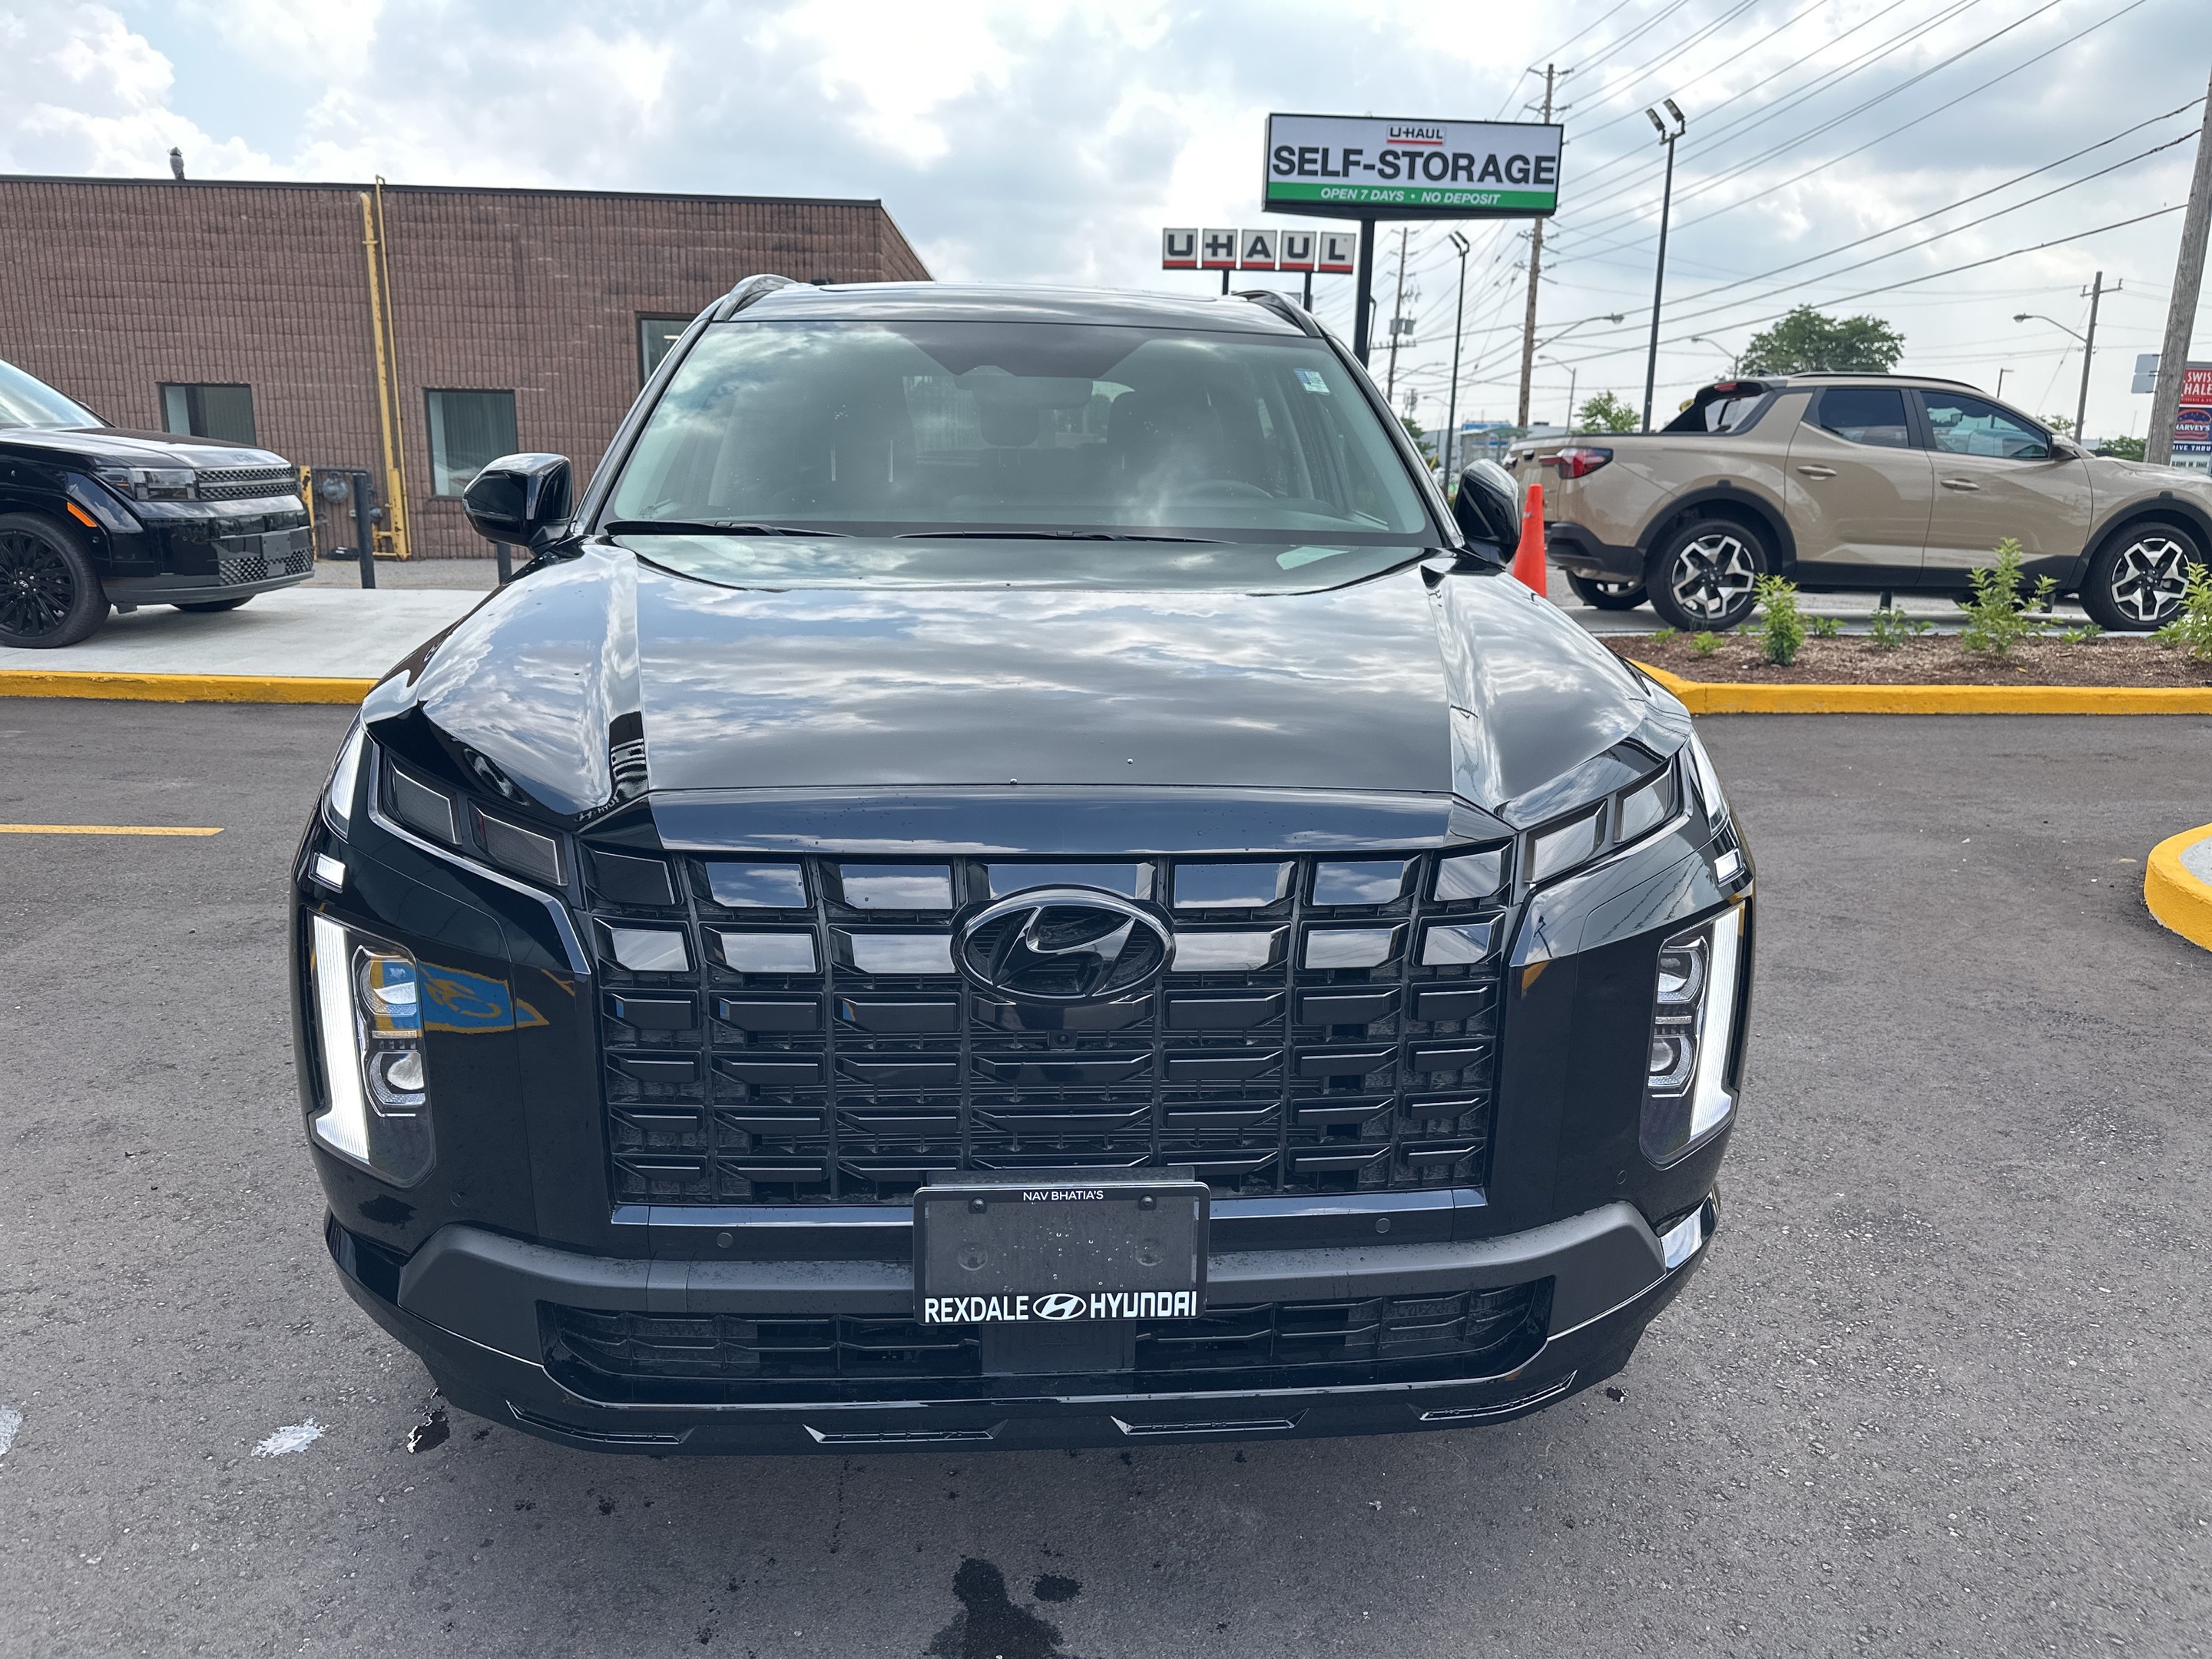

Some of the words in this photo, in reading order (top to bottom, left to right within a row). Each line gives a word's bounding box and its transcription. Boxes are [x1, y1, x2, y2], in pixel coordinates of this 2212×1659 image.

[1272, 144, 1556, 186] SELF-STORAGE
[1320, 187, 1357, 200] OPEN
[1360, 189, 1369, 200] 7
[1370, 190, 1405, 202] DAYS
[1421, 192, 1442, 204] NO
[1443, 193, 1501, 204] DEPOSIT
[2187, 372, 2212, 382] SWIS
[2182, 382, 2212, 396] HALE
[1023, 1190, 1049, 1201] NAV
[1051, 1190, 1104, 1200] BHATIA'S
[925, 1295, 1029, 1323] REXDALE
[1090, 1290, 1197, 1319] HYUNDAI
